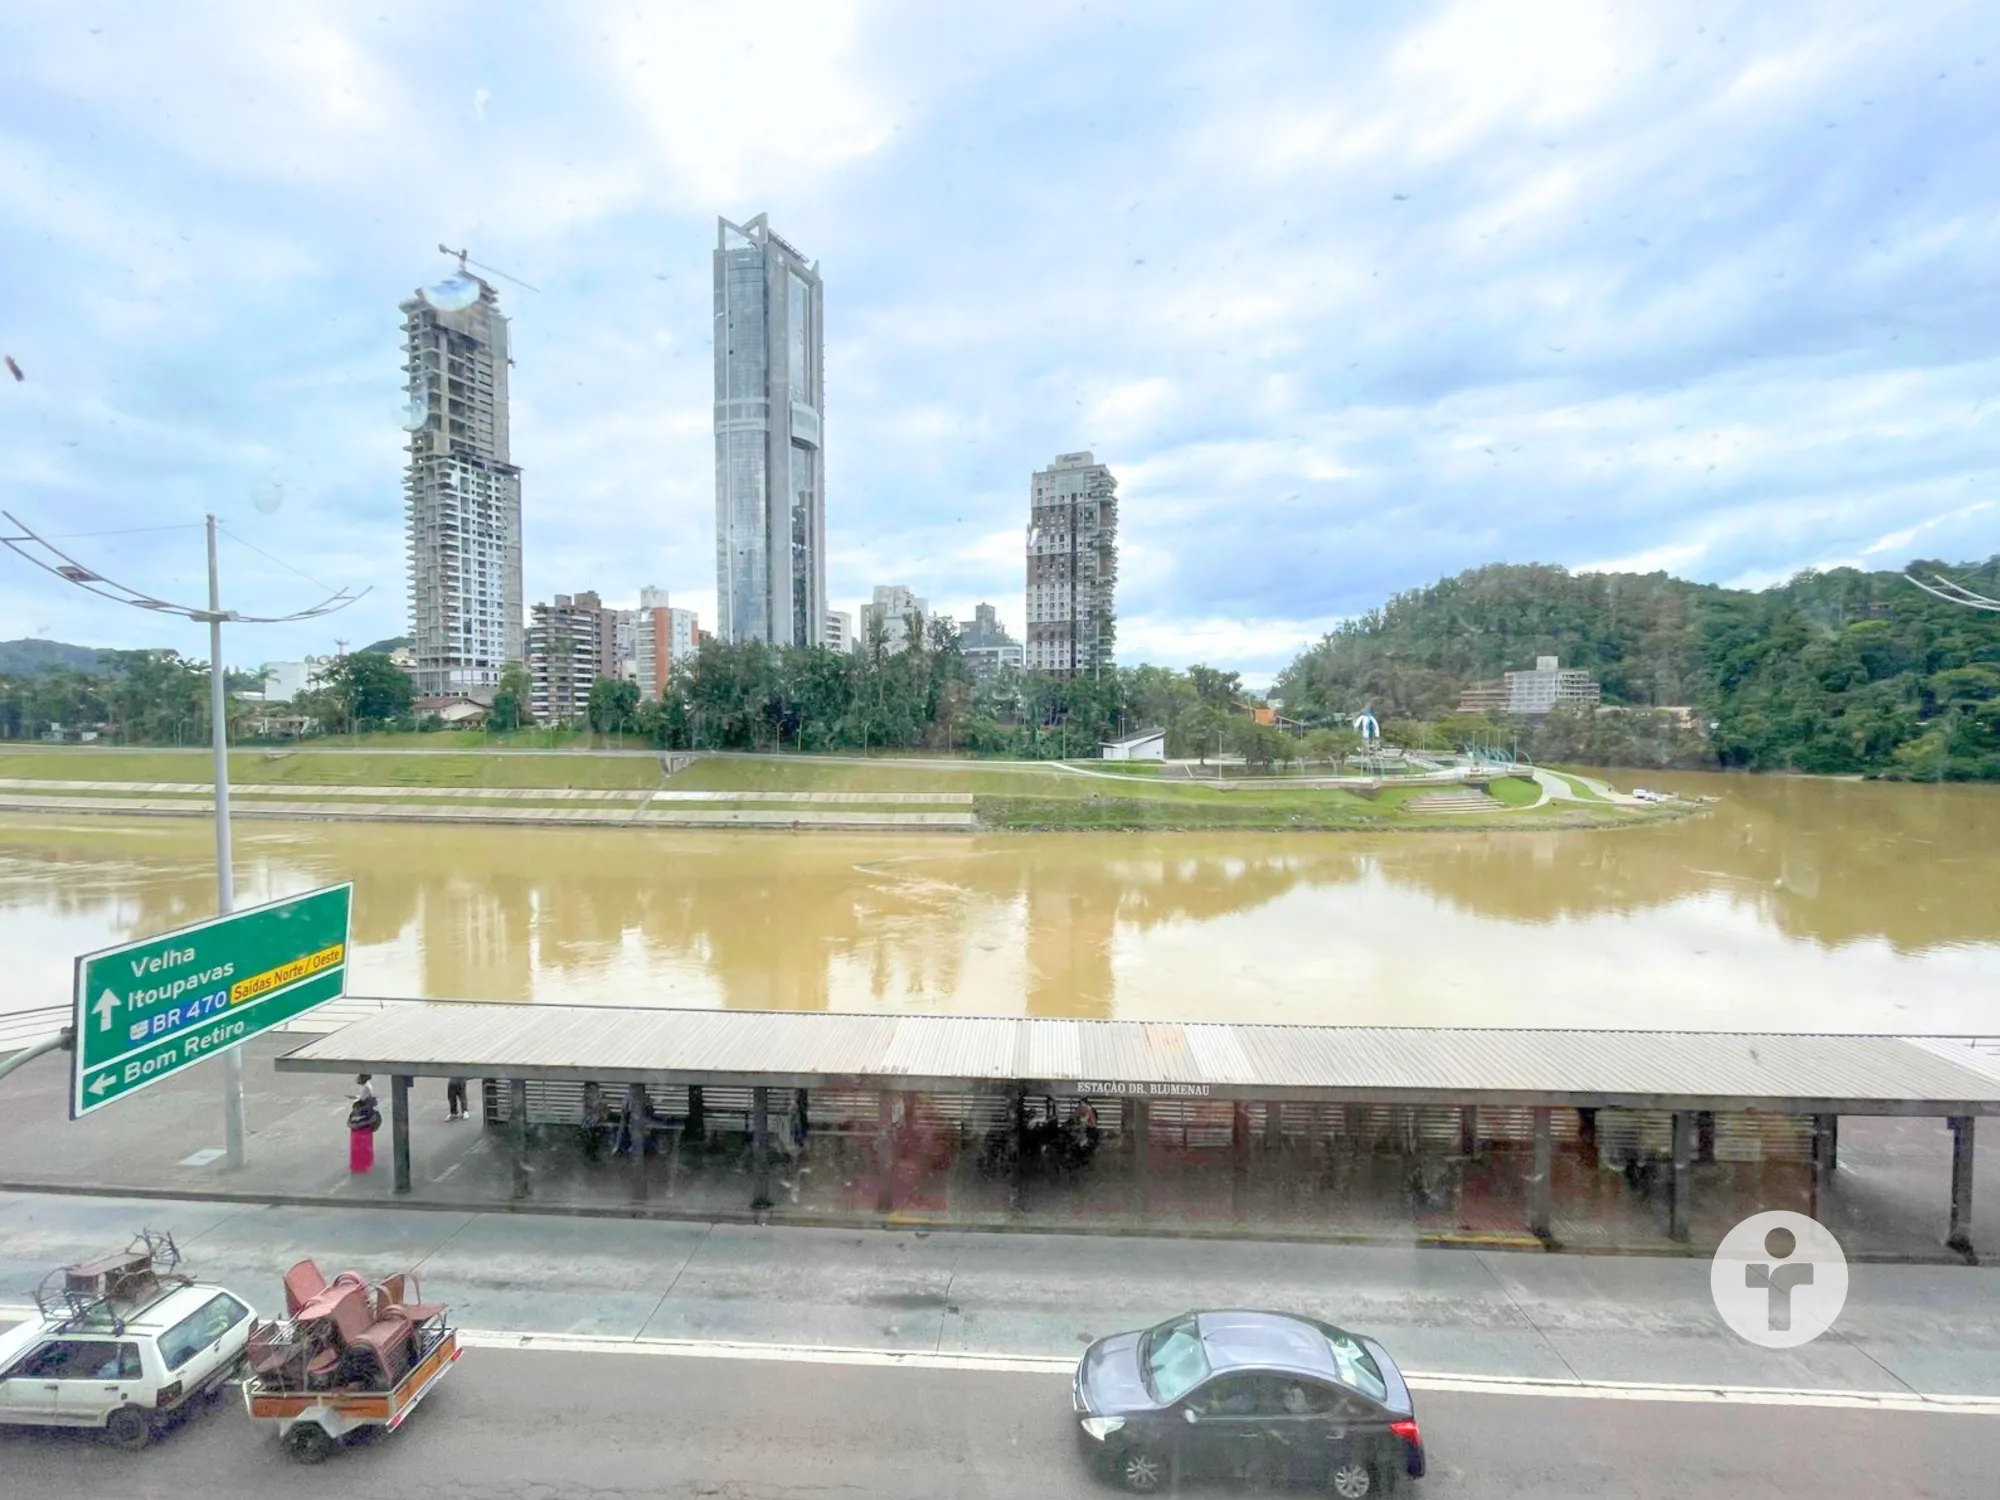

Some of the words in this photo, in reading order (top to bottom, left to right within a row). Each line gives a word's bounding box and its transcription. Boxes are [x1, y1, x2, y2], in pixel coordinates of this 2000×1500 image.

[130, 947, 195, 977] Velha
[275, 963, 303, 983] Norte
[313, 949, 340, 968] Oeste
[128, 962, 234, 1011] Itoupavas
[153, 1008, 181, 1034] BR
[186, 991, 227, 1018] 470
[124, 1050, 177, 1084] Bom
[184, 1021, 244, 1057] Retiro
[1150, 1084, 1210, 1096] BLUMENAU
